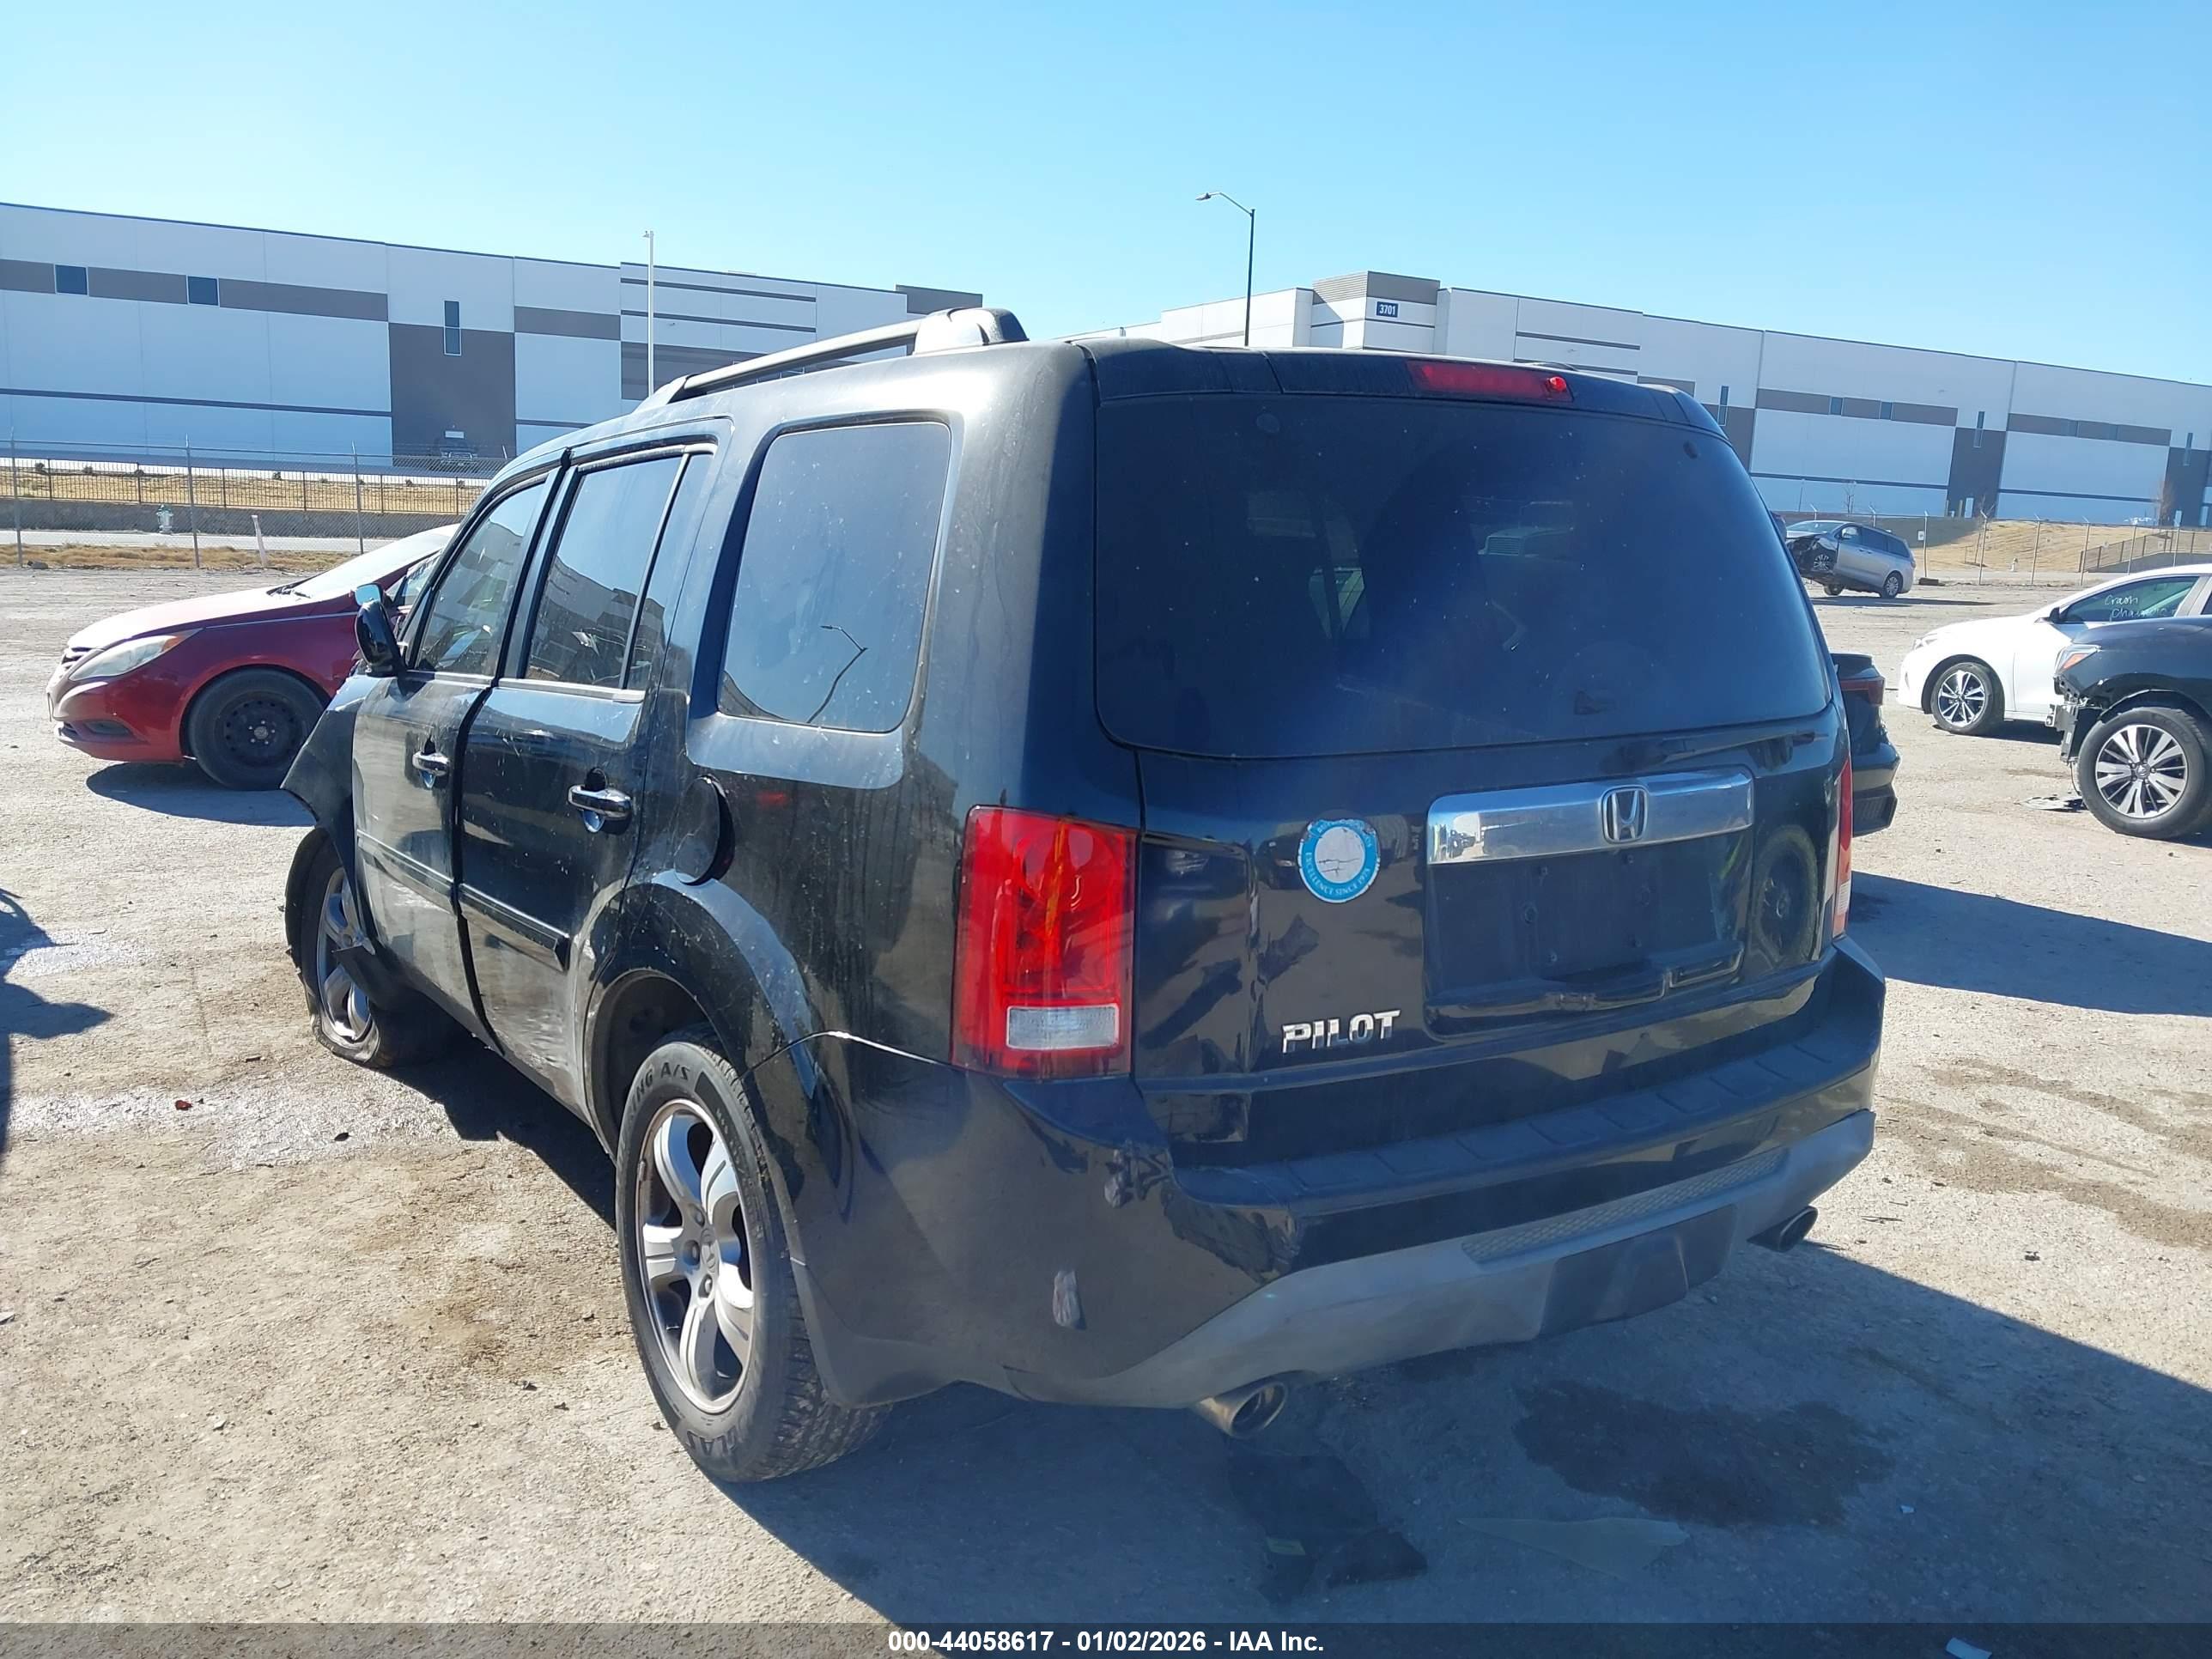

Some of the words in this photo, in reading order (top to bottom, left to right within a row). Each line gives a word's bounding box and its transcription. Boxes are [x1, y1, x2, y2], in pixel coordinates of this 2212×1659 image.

[1379, 304, 1396, 315] 3701
[1305, 852, 1334, 895] EXCELLENCE
[1335, 883, 1358, 896] SINCE
[1282, 1010, 1401, 1054] PILOT
[659, 1061, 691, 1080] A/S
